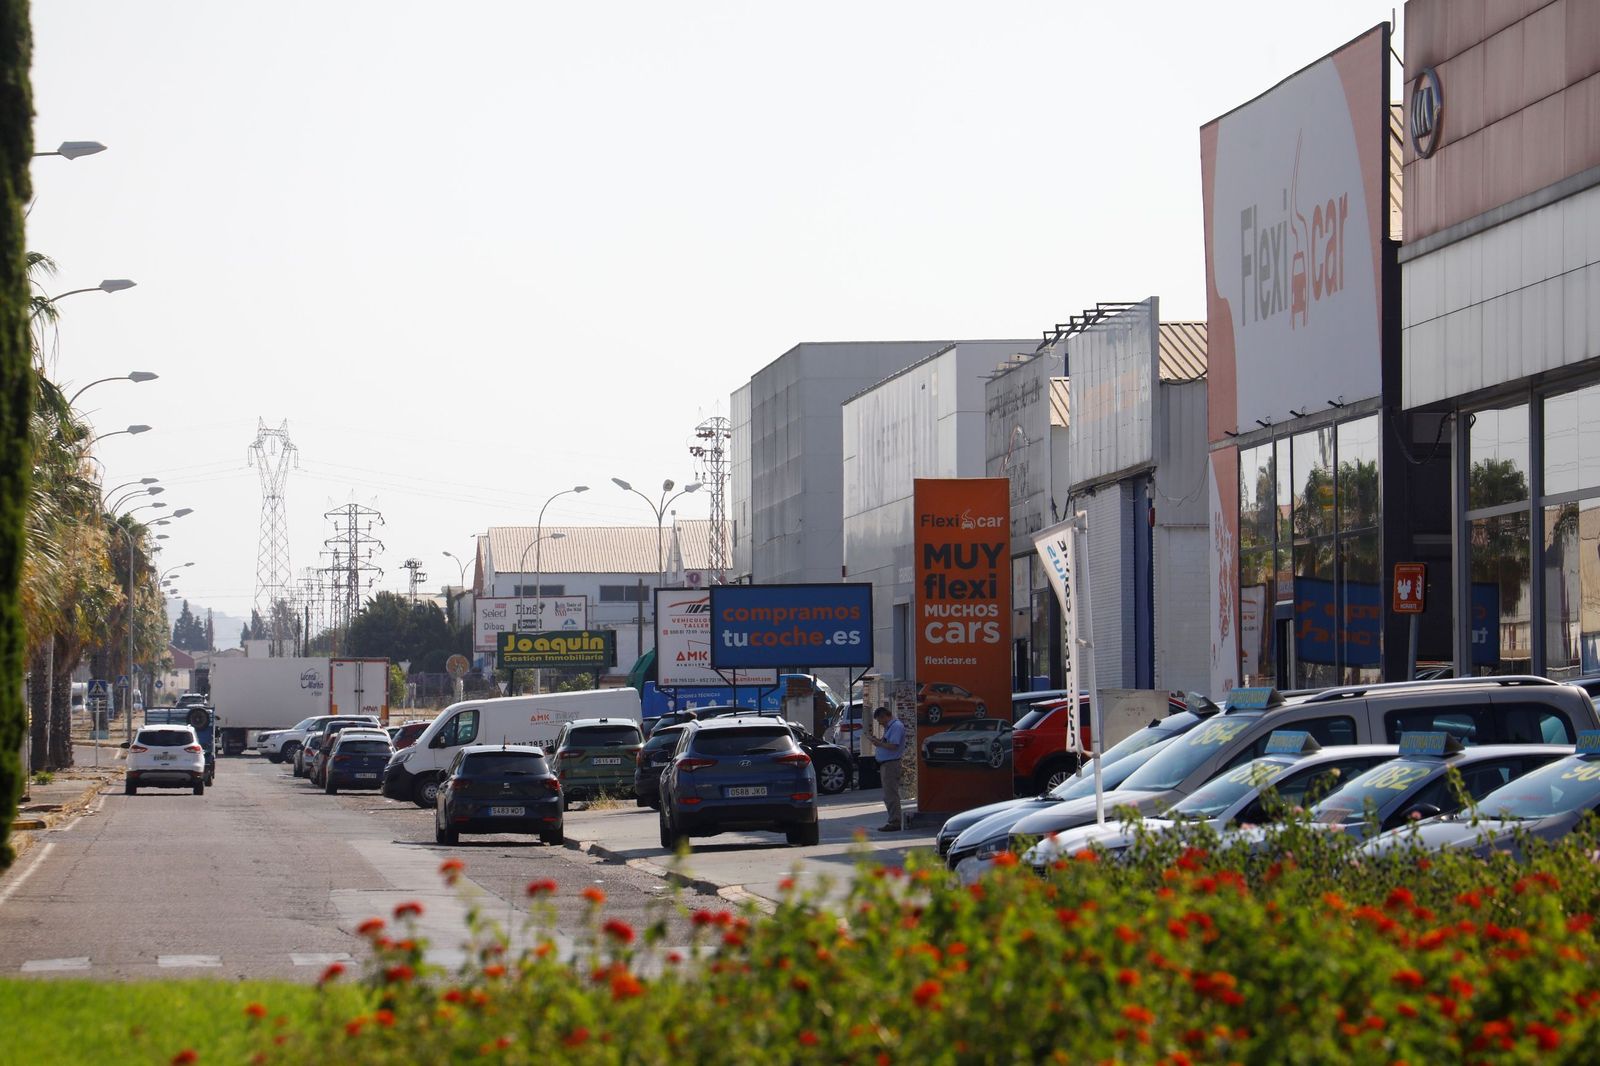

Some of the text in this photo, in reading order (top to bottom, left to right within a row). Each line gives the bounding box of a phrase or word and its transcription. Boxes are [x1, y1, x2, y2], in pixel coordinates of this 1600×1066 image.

[1241, 188, 1348, 326] Flexi car
[920, 514, 1004, 528] Flexi car
[924, 543, 1005, 570] MUY
[924, 573, 998, 600] flexi
[722, 605, 861, 626] compramos
[924, 604, 999, 617] MUCHOS
[722, 624, 861, 647] tucoche.es
[925, 621, 1000, 644] cars
[676, 651, 708, 661] AMK
[924, 656, 977, 665] flexicar.es
[530, 714, 550, 722] AMK
